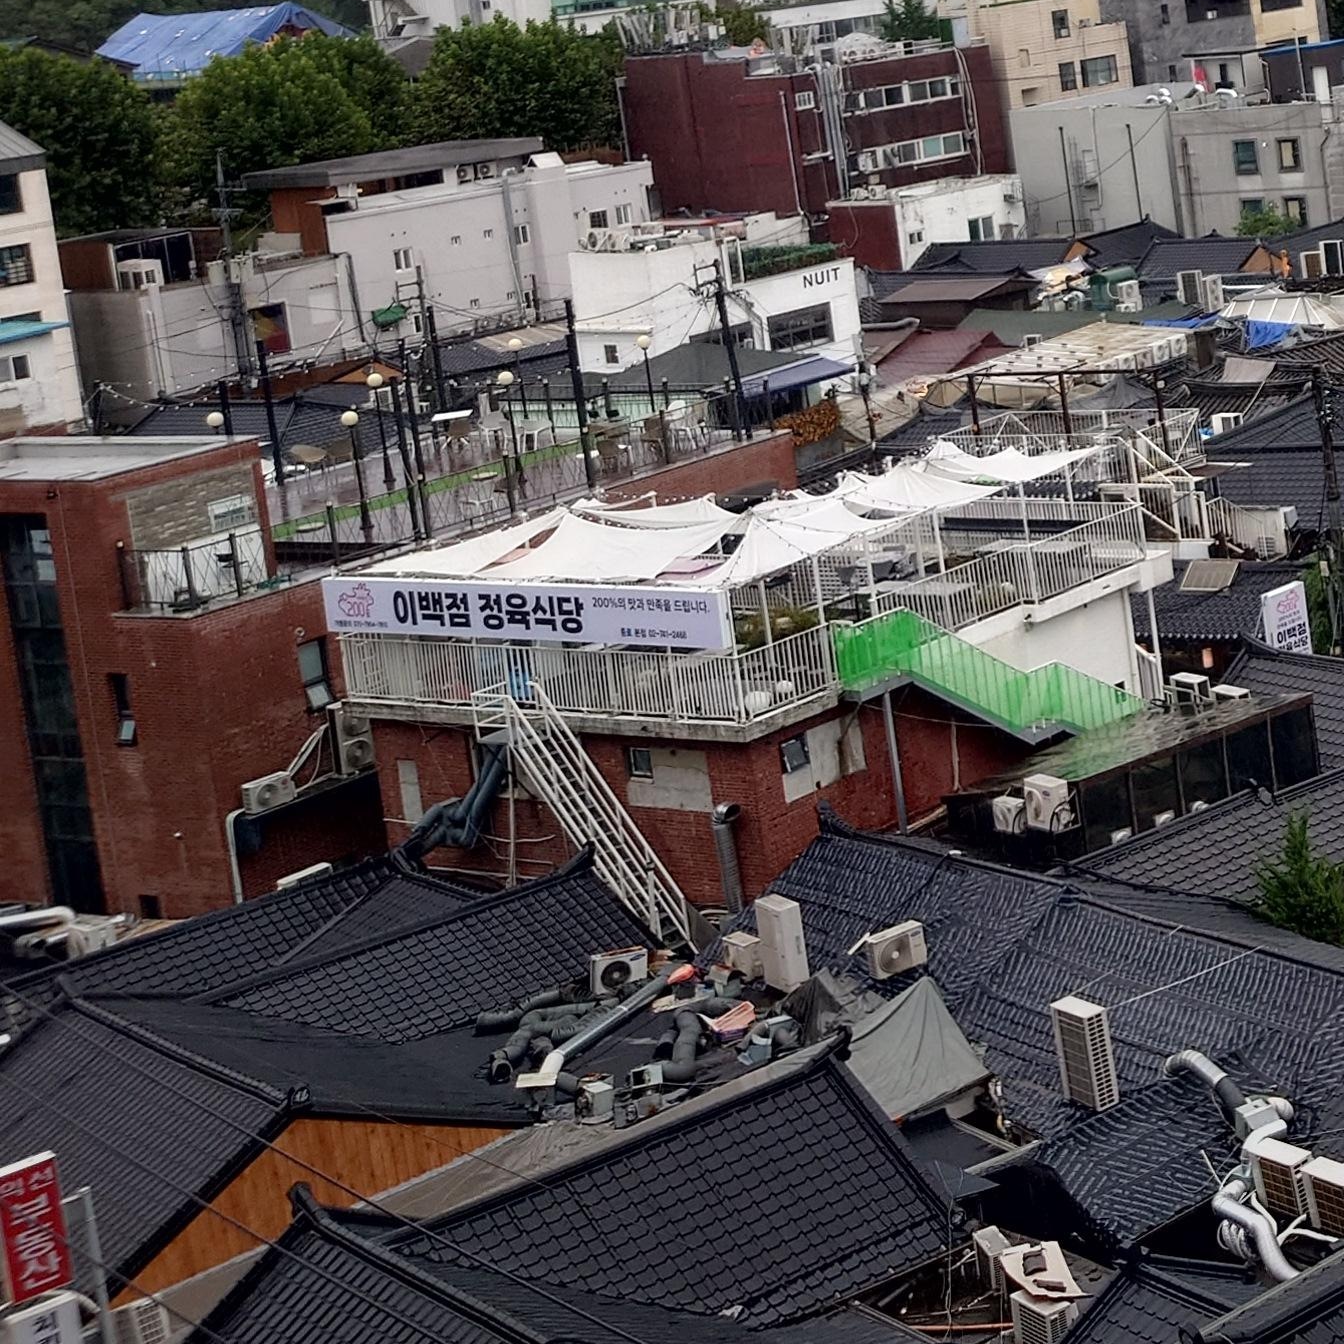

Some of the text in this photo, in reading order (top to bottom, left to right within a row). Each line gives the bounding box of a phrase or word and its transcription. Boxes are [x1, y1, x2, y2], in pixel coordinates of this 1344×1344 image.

[802, 266, 841, 289] NUIT
[393, 590, 584, 634] 이백점 정육식당
[591, 596, 711, 614] 200%의 맛과 만족을 드립니다.
[1277, 621, 1308, 644] 이백점
